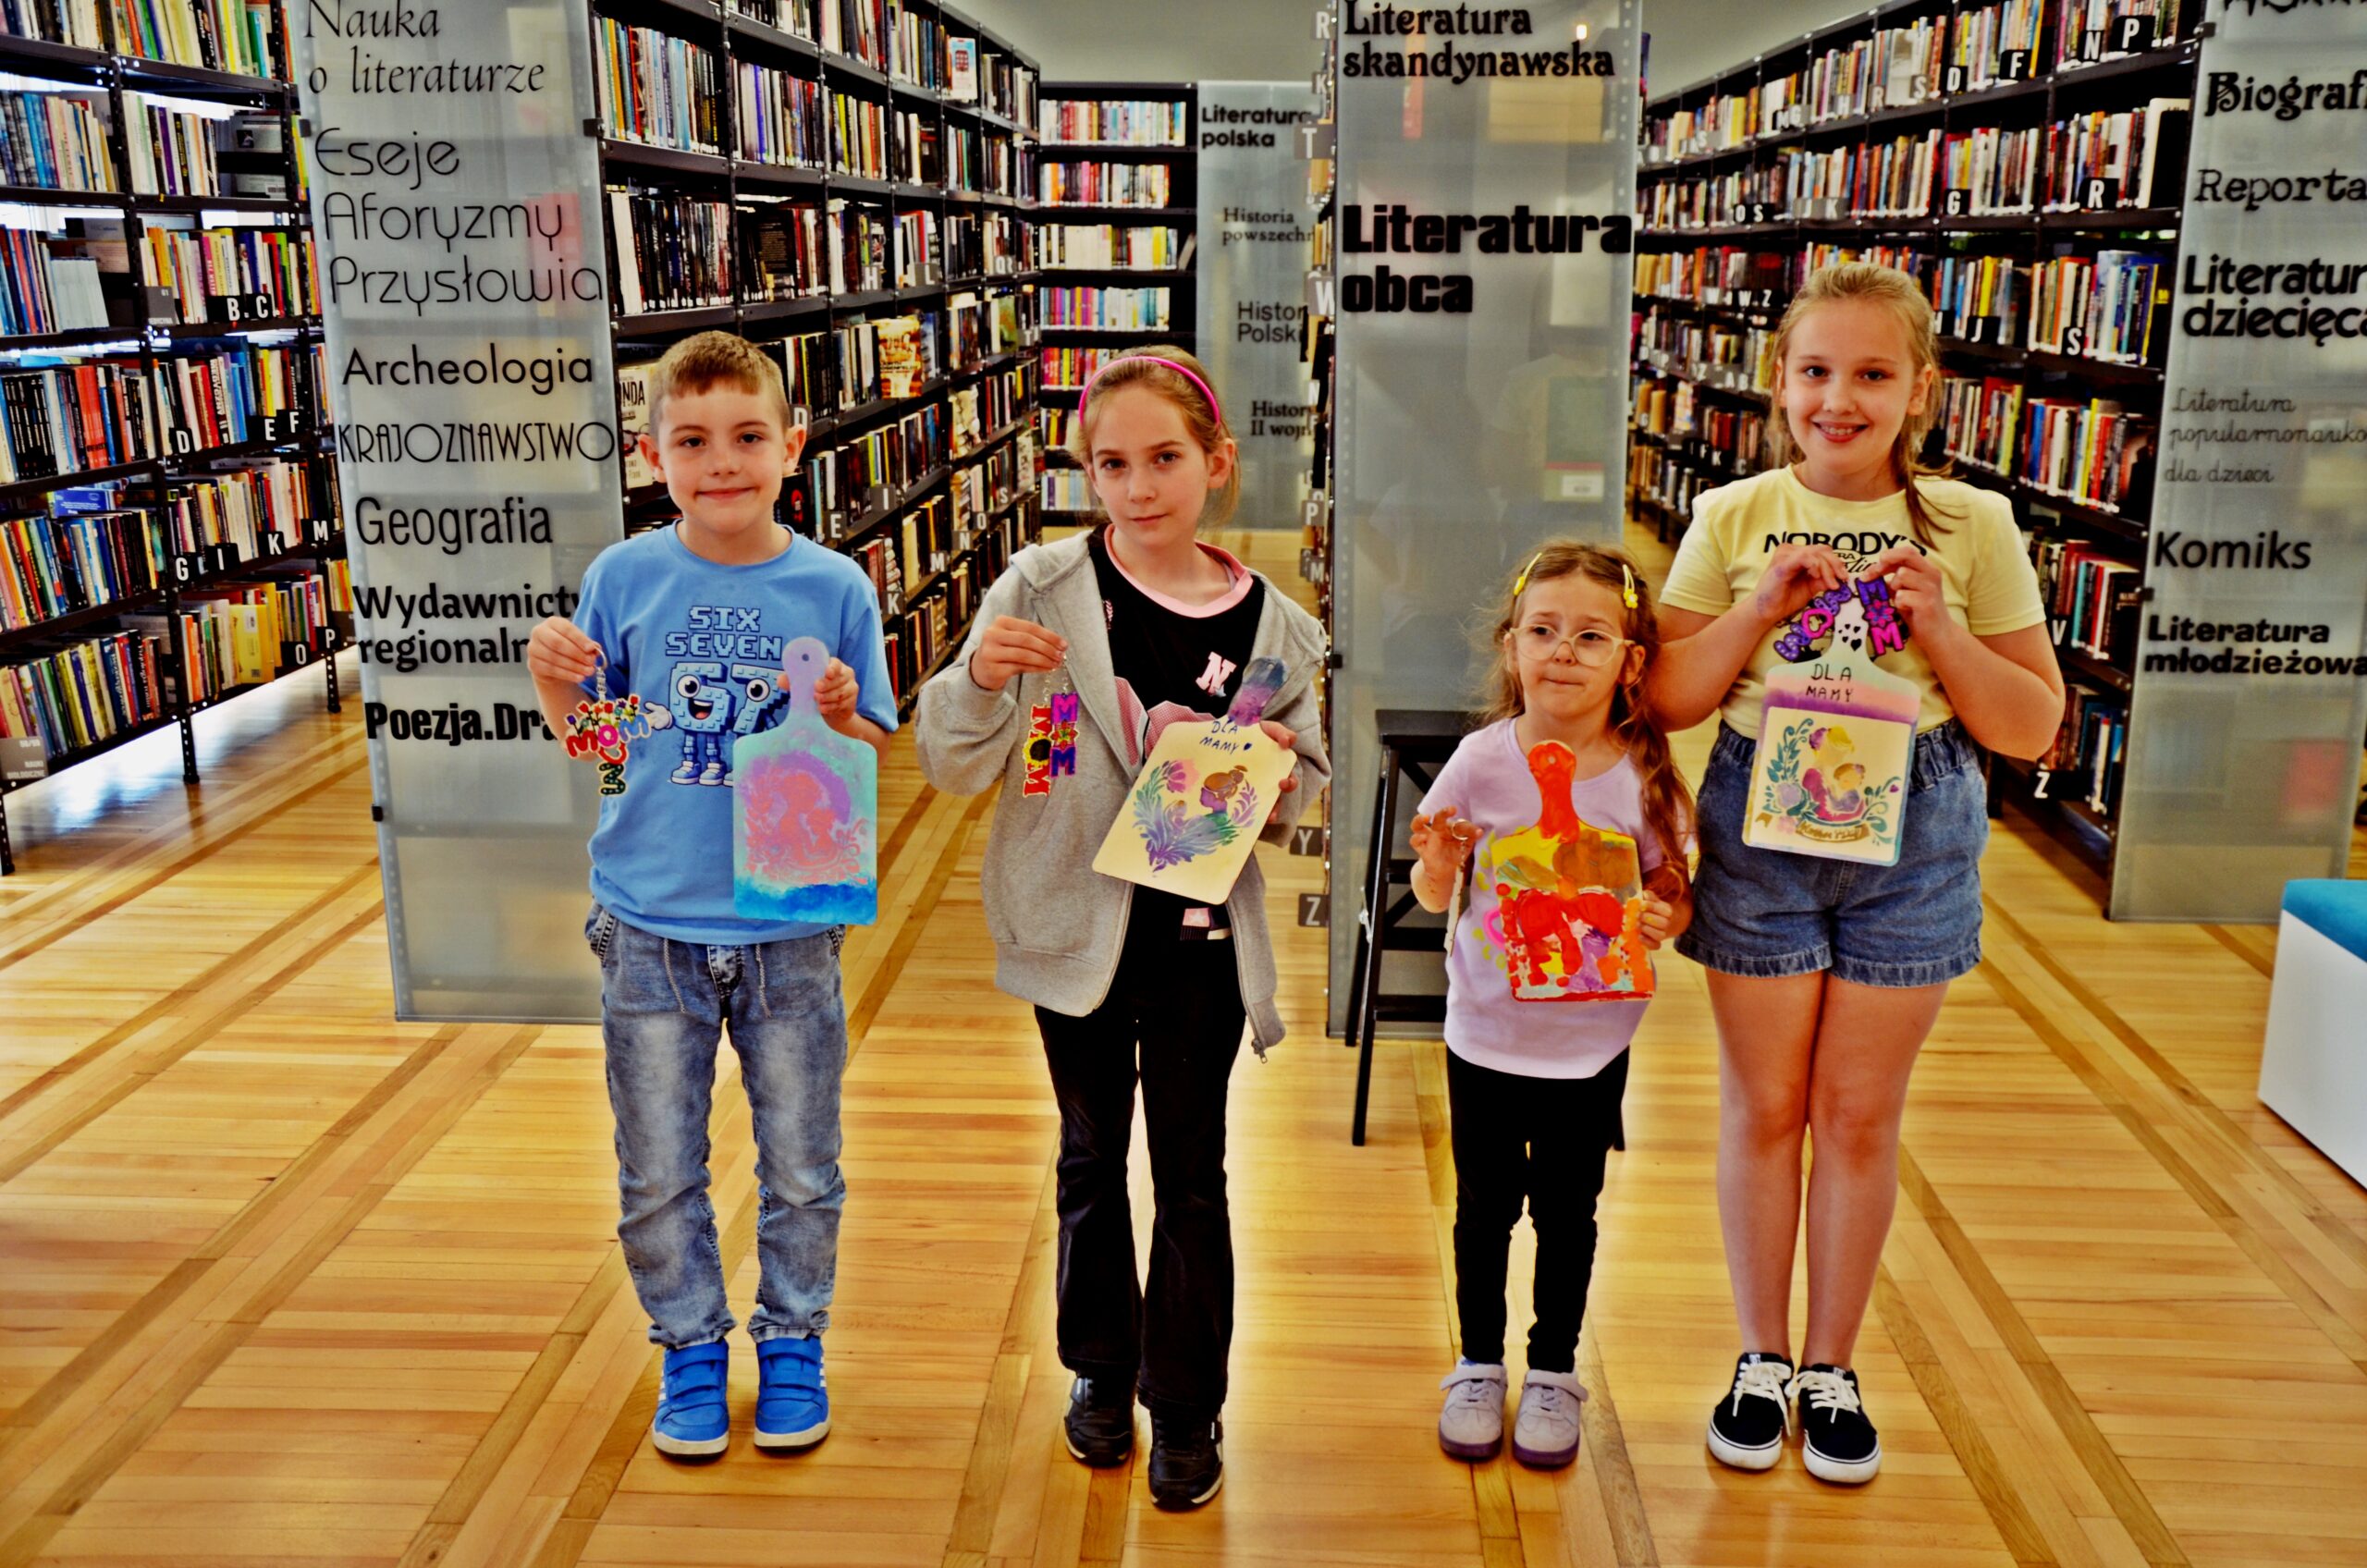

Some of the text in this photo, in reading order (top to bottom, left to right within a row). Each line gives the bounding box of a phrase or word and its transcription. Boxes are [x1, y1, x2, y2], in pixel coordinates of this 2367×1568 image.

[306, 0, 440, 38] Nauka
[1316, 11, 1330, 39] R
[1344, 0, 1532, 35] Literatura
[2084, 31, 2101, 59] N
[2121, 18, 2140, 49] P
[309, 45, 546, 93] o literaturze
[1343, 41, 1614, 85] skandynawska
[2009, 52, 2024, 78] F
[1914, 75, 1927, 98] S
[1946, 67, 1961, 92] D
[2204, 69, 2367, 121] Biograf
[1202, 129, 1275, 149] polska
[1302, 128, 1318, 159] T
[315, 128, 460, 190] Eseje
[1946, 191, 1961, 215] G
[2088, 179, 2105, 209] R
[324, 192, 562, 252] Aforyzmy
[1223, 207, 1294, 223] Historia
[1343, 205, 1632, 253] Literatura
[330, 254, 603, 317] Przysłowia
[1342, 265, 1473, 312] obca
[227, 297, 240, 321] B
[256, 295, 269, 318] C
[1970, 317, 1983, 343] J
[2067, 328, 2081, 356] S
[342, 343, 593, 395] Archeologia
[620, 380, 646, 408] NDA
[2172, 387, 2296, 412] Literatura
[264, 418, 276, 441] E
[289, 411, 300, 434] F
[1251, 420, 1265, 435] II
[176, 430, 190, 454] D
[337, 422, 615, 463] KRAJOZNAWSTWO
[2165, 456, 2201, 482] dla
[355, 496, 553, 555] Geografia
[830, 513, 843, 539] E
[1305, 502, 1319, 526] P
[268, 533, 282, 556] K
[313, 520, 329, 542] M
[217, 548, 225, 570] I
[2154, 531, 2312, 570] Komiks
[175, 557, 190, 582] G
[888, 592, 901, 615] K
[688, 606, 761, 633] SIX
[2052, 619, 2067, 645] V
[2148, 616, 2329, 643] Literatura
[325, 629, 337, 649] P
[665, 632, 782, 660] SEVEN
[295, 643, 307, 666] O
[2144, 647, 2367, 677] młodzieżowa
[1196, 651, 1238, 695] N
[1810, 663, 1853, 682] DLA
[566, 713, 651, 760] MOM
[2034, 771, 2051, 799] Z
[1297, 828, 1314, 855] Y
[1306, 896, 1322, 925] Z
